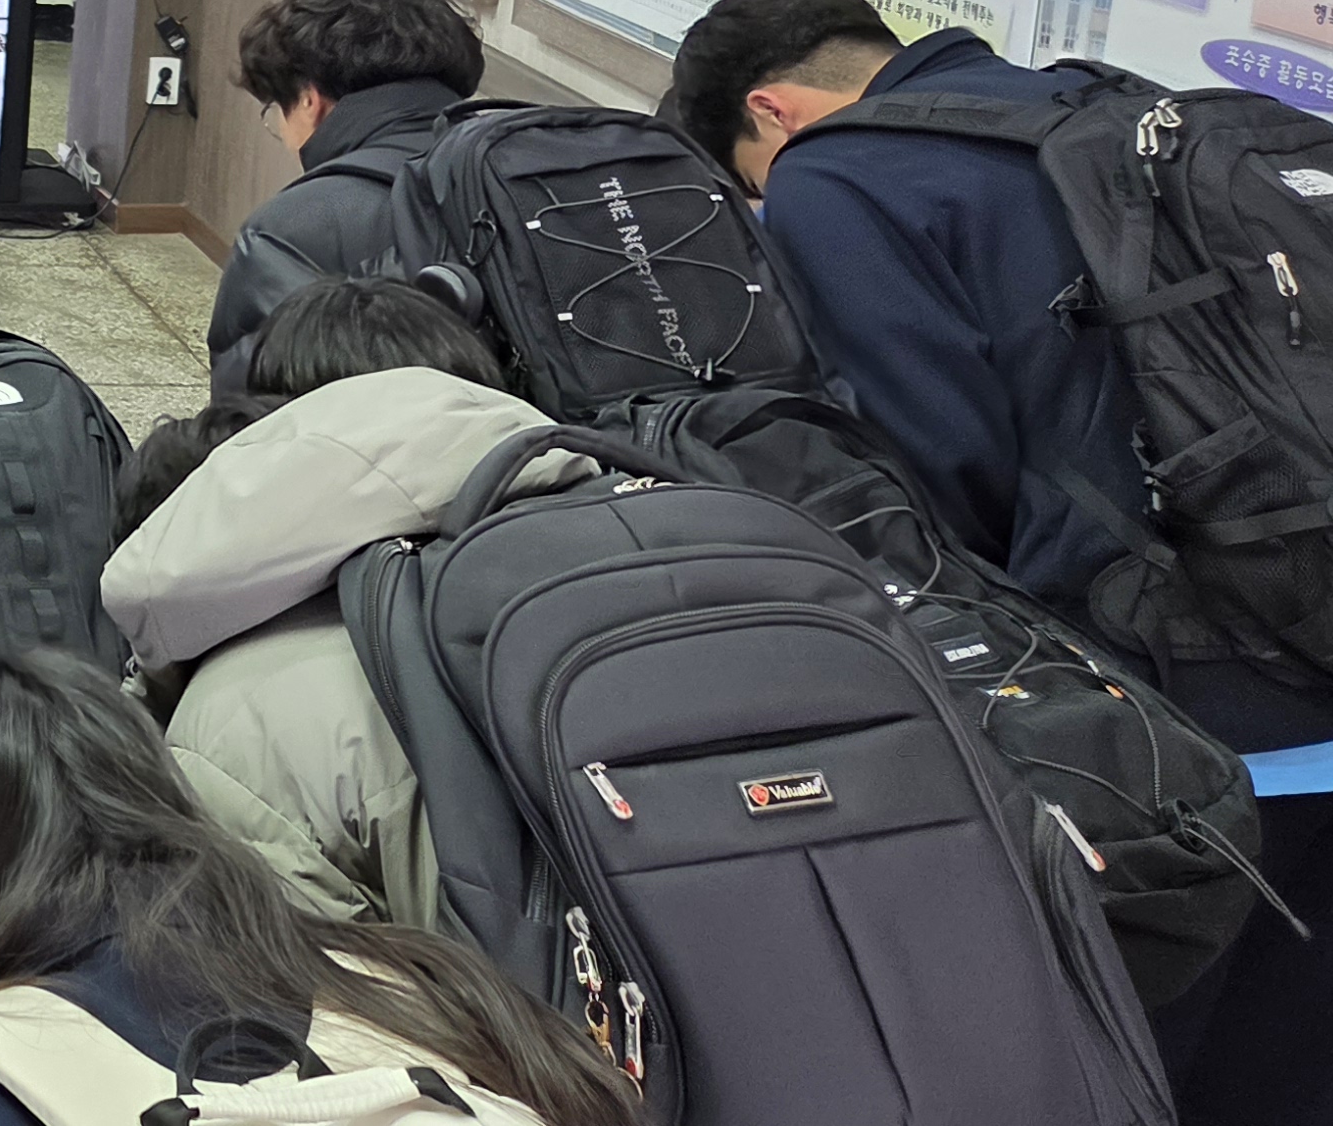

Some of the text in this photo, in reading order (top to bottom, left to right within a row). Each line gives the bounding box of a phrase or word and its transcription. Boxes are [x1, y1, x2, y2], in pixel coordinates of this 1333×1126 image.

[896, 3, 922, 24] 희망과
[962, 0, 995, 28] 전해주는
[1225, 46, 1271, 78] 포승중
[600, 177, 634, 222] THE
[768, 776, 822, 800] Valuable
